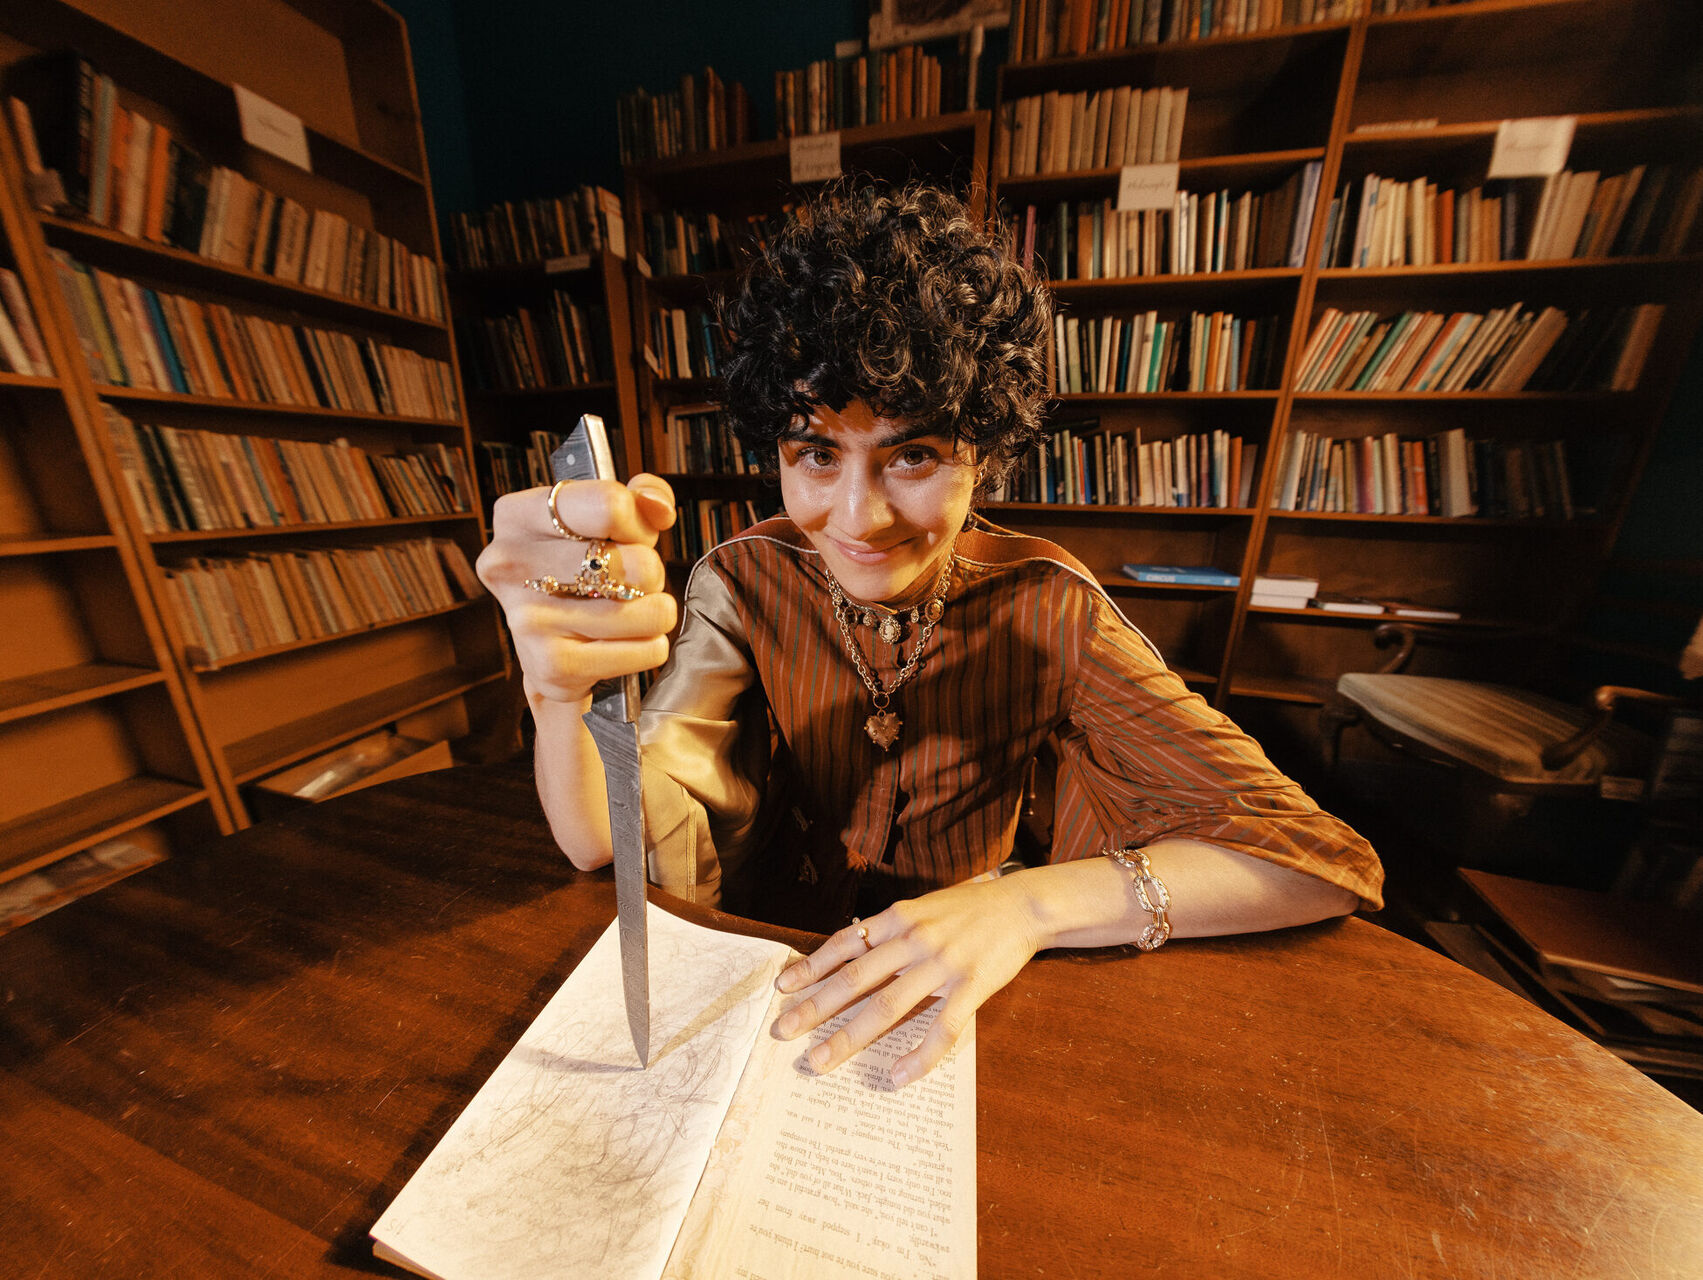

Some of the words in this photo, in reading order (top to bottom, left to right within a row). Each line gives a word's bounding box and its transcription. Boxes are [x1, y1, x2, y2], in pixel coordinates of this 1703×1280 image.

[801, 1115, 814, 1123] said
[894, 1130, 907, 1140] had
[789, 1145, 807, 1157] know
[853, 1150, 867, 1160] very
[769, 1162, 781, 1170] she
[794, 1159, 808, 1167] and
[841, 1161, 856, 1172] here
[799, 1172, 813, 1180] you
[885, 1172, 904, 1184] sorry
[776, 1178, 788, 1186] am
[793, 1184, 822, 1197] grateful
[874, 1183, 886, 1193] the
[757, 1198, 770, 1210] her
[775, 1205, 793, 1218] from
[860, 1205, 873, 1214] she
[903, 1204, 915, 1216] did
[917, 1209, 931, 1219] you
[798, 1211, 817, 1224] away
[896, 1216, 908, 1228] tell
[821, 1221, 850, 1236] stepped
